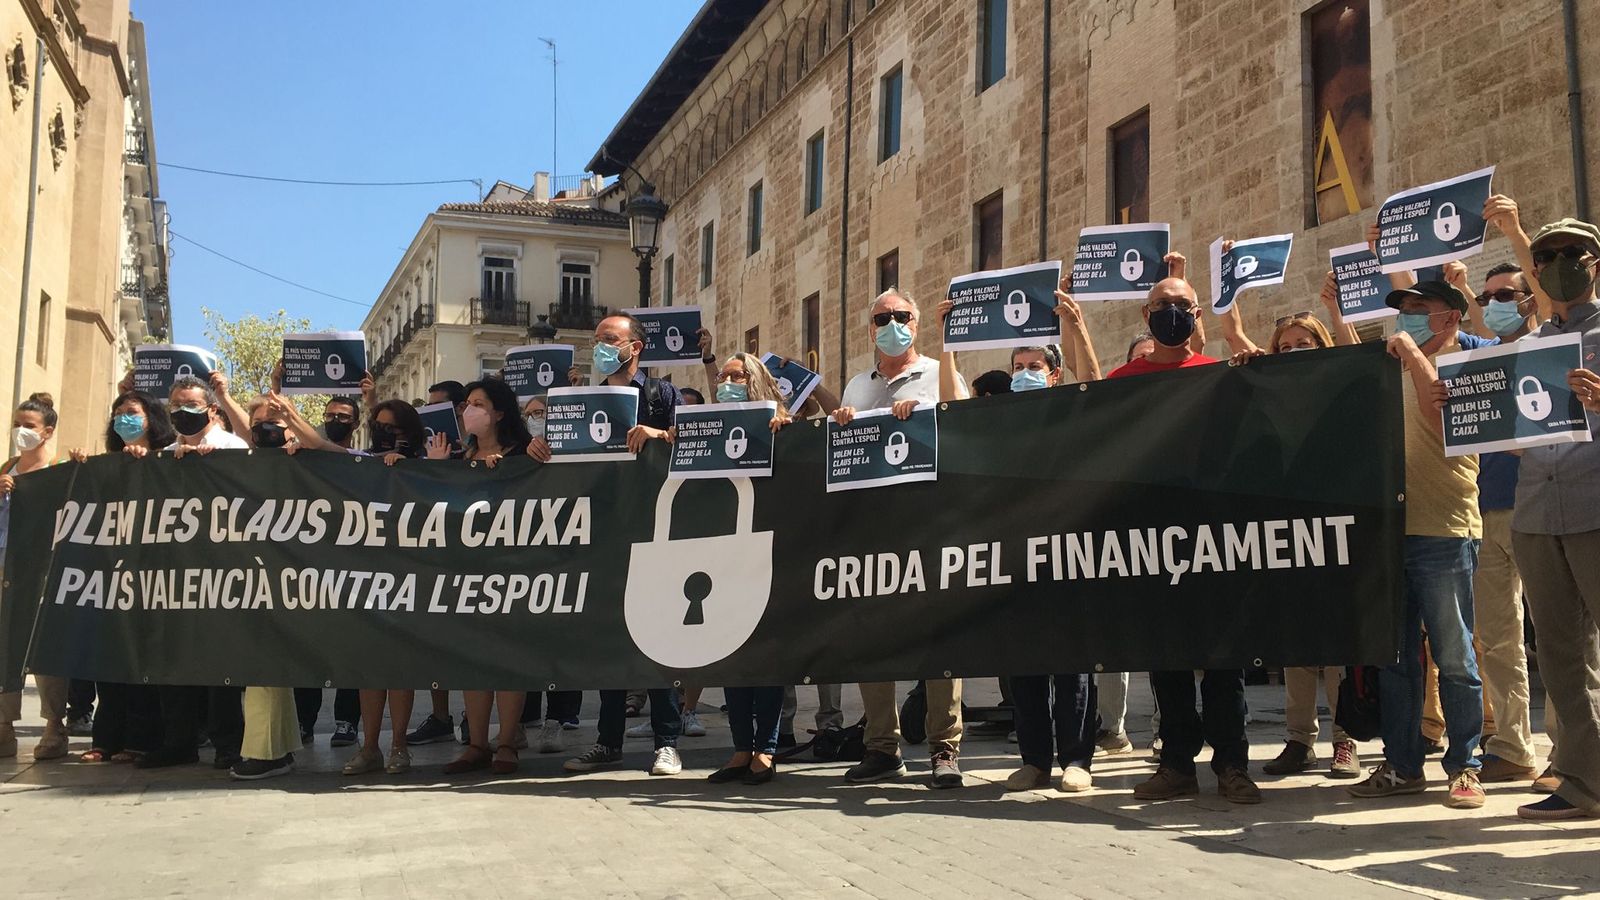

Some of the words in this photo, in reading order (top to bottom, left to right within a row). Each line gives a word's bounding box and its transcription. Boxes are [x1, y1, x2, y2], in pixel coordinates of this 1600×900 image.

[1315, 110, 1362, 214] A
[1391, 206, 1403, 216] PAÍS
[1404, 198, 1431, 211] VALENCIÀ
[1381, 216, 1403, 224] CONTRA
[1382, 227, 1400, 237] VOLEM
[1401, 224, 1412, 233] LES
[1092, 242, 1116, 250] VALENCIÀ
[1380, 238, 1399, 247] CLAUS
[1382, 247, 1399, 257] CAIXA
[1345, 262, 1358, 271] PAÍS
[1073, 271, 1090, 279] CLAUS
[1338, 272, 1360, 280] CONTRA
[974, 284, 1000, 294] VALENCIÀ
[1340, 282, 1359, 292] VOLEM
[1361, 280, 1371, 288] LES
[1341, 292, 1360, 300] CLAUS
[1362, 289, 1369, 297] DE
[1344, 300, 1362, 308] CAIXA
[952, 308, 970, 317] VOLEM
[950, 317, 970, 326] CLAUS
[1456, 374, 1471, 386] PAÍS
[1472, 368, 1506, 383] VALENCIÀ
[553, 404, 562, 412] PAÍS
[562, 403, 585, 411] VALENCIÀ
[1451, 403, 1476, 414] VOLEM
[1478, 400, 1491, 410] LES
[1452, 414, 1478, 425] CLAUS
[1480, 412, 1491, 422] DE
[1492, 410, 1501, 420] LA
[686, 421, 697, 429] PAÍS
[699, 419, 723, 428] VALENCIÀ
[841, 428, 852, 438] PAÍS
[854, 425, 880, 435] VALENCIÀ
[1453, 426, 1478, 436] CAIXA
[834, 450, 852, 458] VOLEM
[853, 448, 864, 456] LES
[833, 459, 851, 467] CLAUS
[833, 468, 850, 476] CAIXA
[141, 497, 203, 544] LES
[209, 495, 332, 544] CLAUS
[335, 500, 393, 547] DE
[397, 501, 449, 548] LA
[460, 495, 591, 548] CAIXA
[813, 549, 927, 601] CRIDA
[939, 541, 1012, 590] PEL
[1026, 515, 1356, 586] FINANÇAMENT
[54, 559, 135, 611] PAÍS
[138, 556, 274, 611] VALENCIÀ
[280, 567, 417, 613] CONTRA
[427, 571, 590, 615] L'ESPOLI
